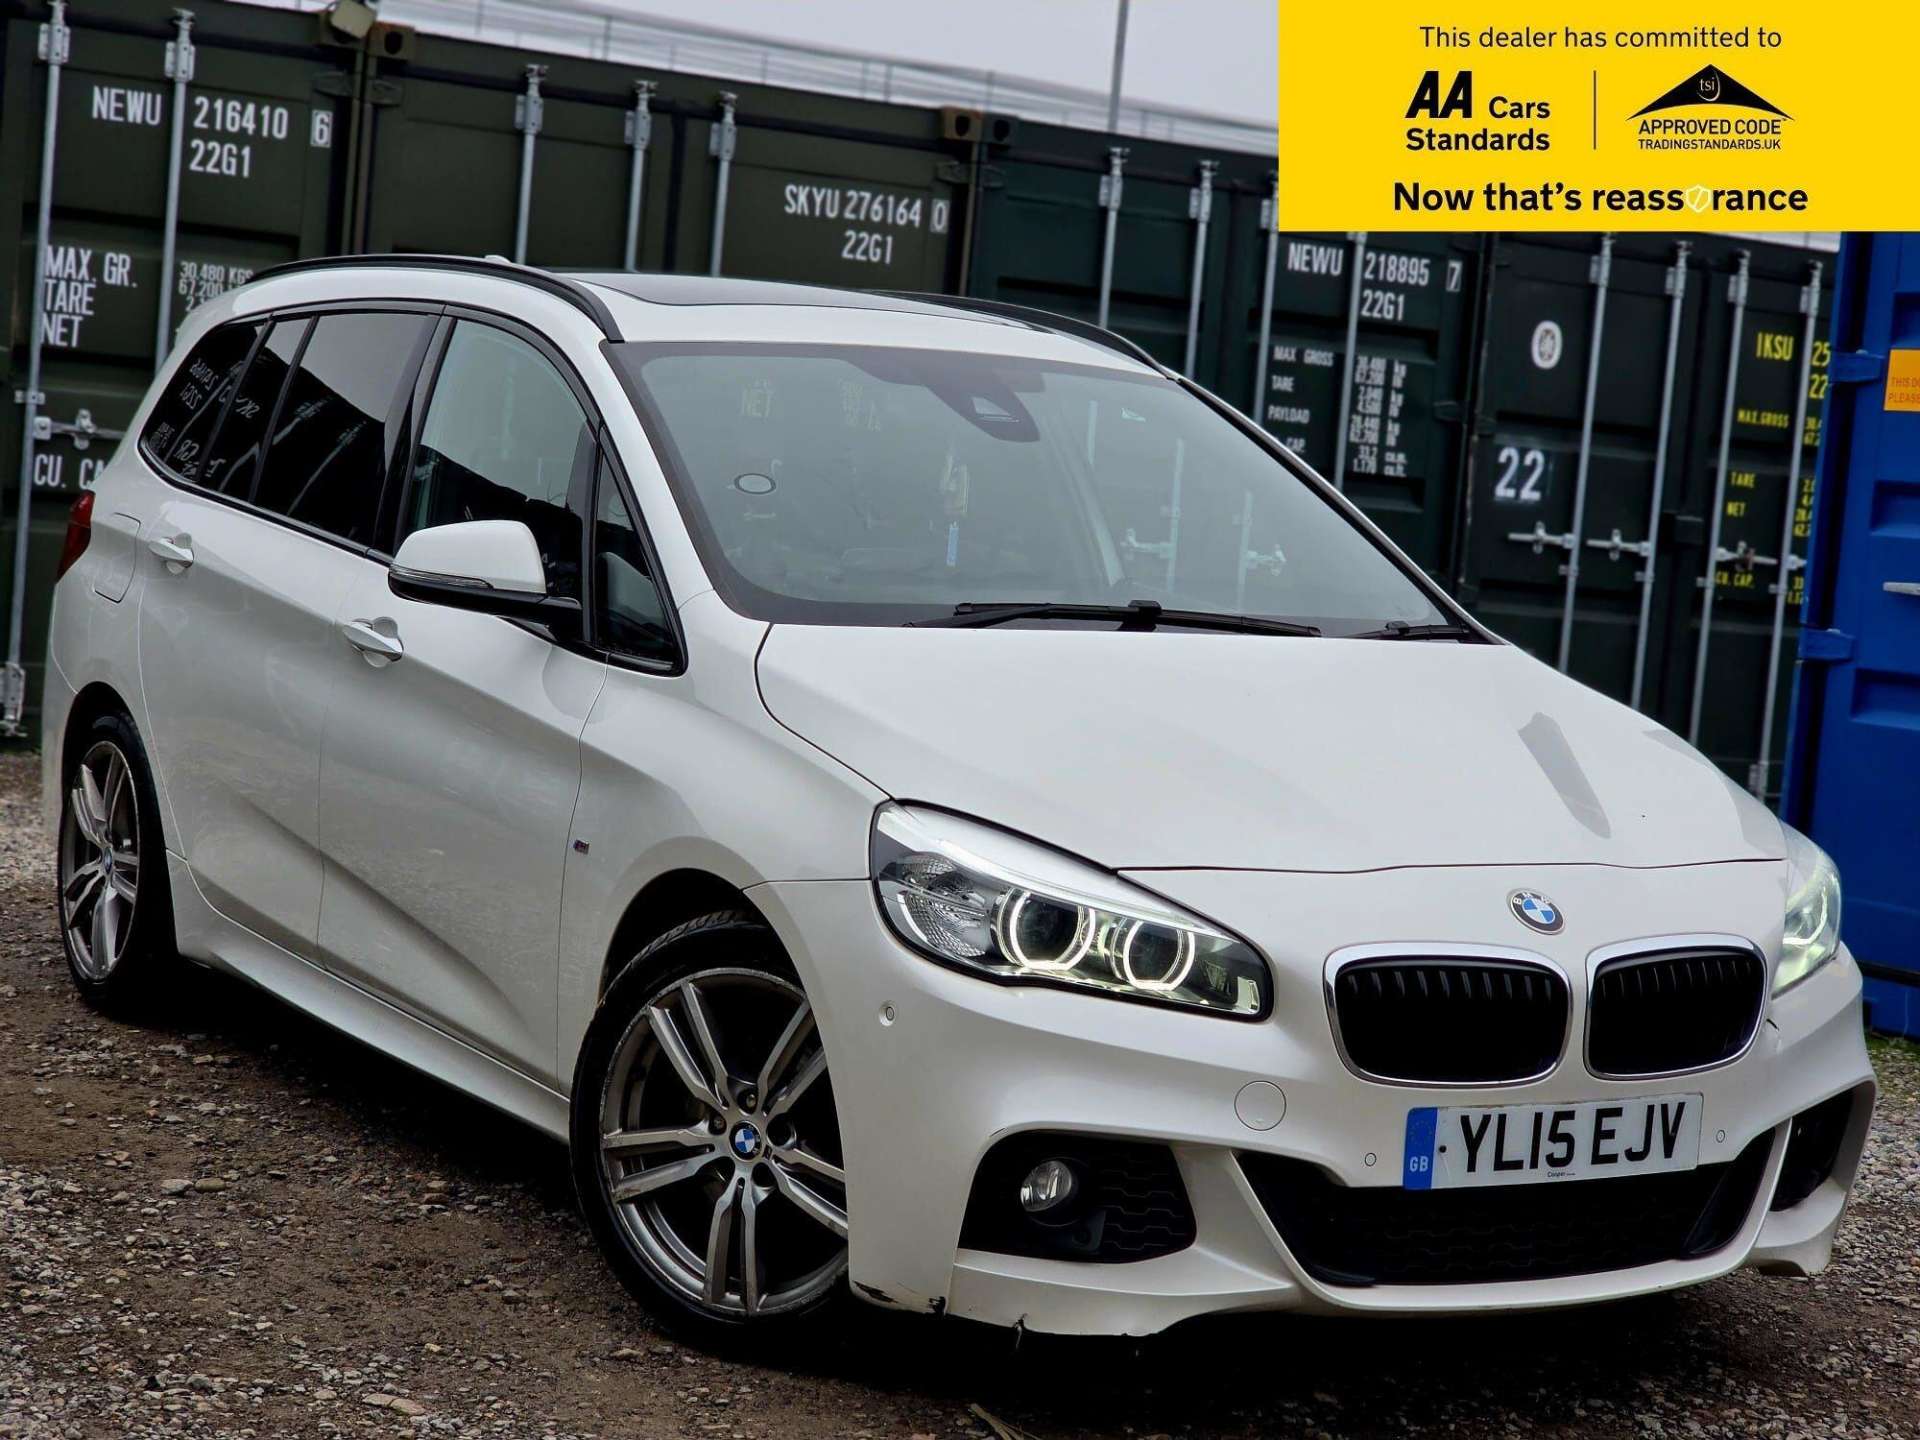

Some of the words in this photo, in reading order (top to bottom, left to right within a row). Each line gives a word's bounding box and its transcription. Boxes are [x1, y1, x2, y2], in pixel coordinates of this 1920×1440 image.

[92, 86, 161, 126] NEWU
[194, 97, 288, 140] 216410
[312, 111, 332, 146] 6
[190, 140, 251, 178] 22G1
[784, 184, 840, 219] SKYU
[844, 190, 922, 229] 276164
[841, 230, 893, 265] 22G1
[45, 244, 97, 283] MAX.
[103, 252, 138, 287] GR.
[1288, 242, 1344, 277] NEWU
[1364, 252, 1431, 287] 218895
[1448, 261, 1462, 291] 7
[44, 278, 96, 316] TARE
[1361, 289, 1405, 321] 22G1
[41, 315, 84, 348] NET
[1756, 332, 1795, 361] IKSU
[1273, 346, 1297, 362] MAX
[1303, 349, 1334, 367] GROSS
[1272, 375, 1295, 392] TARE
[1268, 405, 1310, 424] PAYLOAD
[34, 454, 66, 488] CU.
[1495, 446, 1545, 501] 22
[1459, 1110, 1576, 1173] YL15
[1590, 1102, 1687, 1166] EJV
[1409, 1155, 1429, 1172] GB
